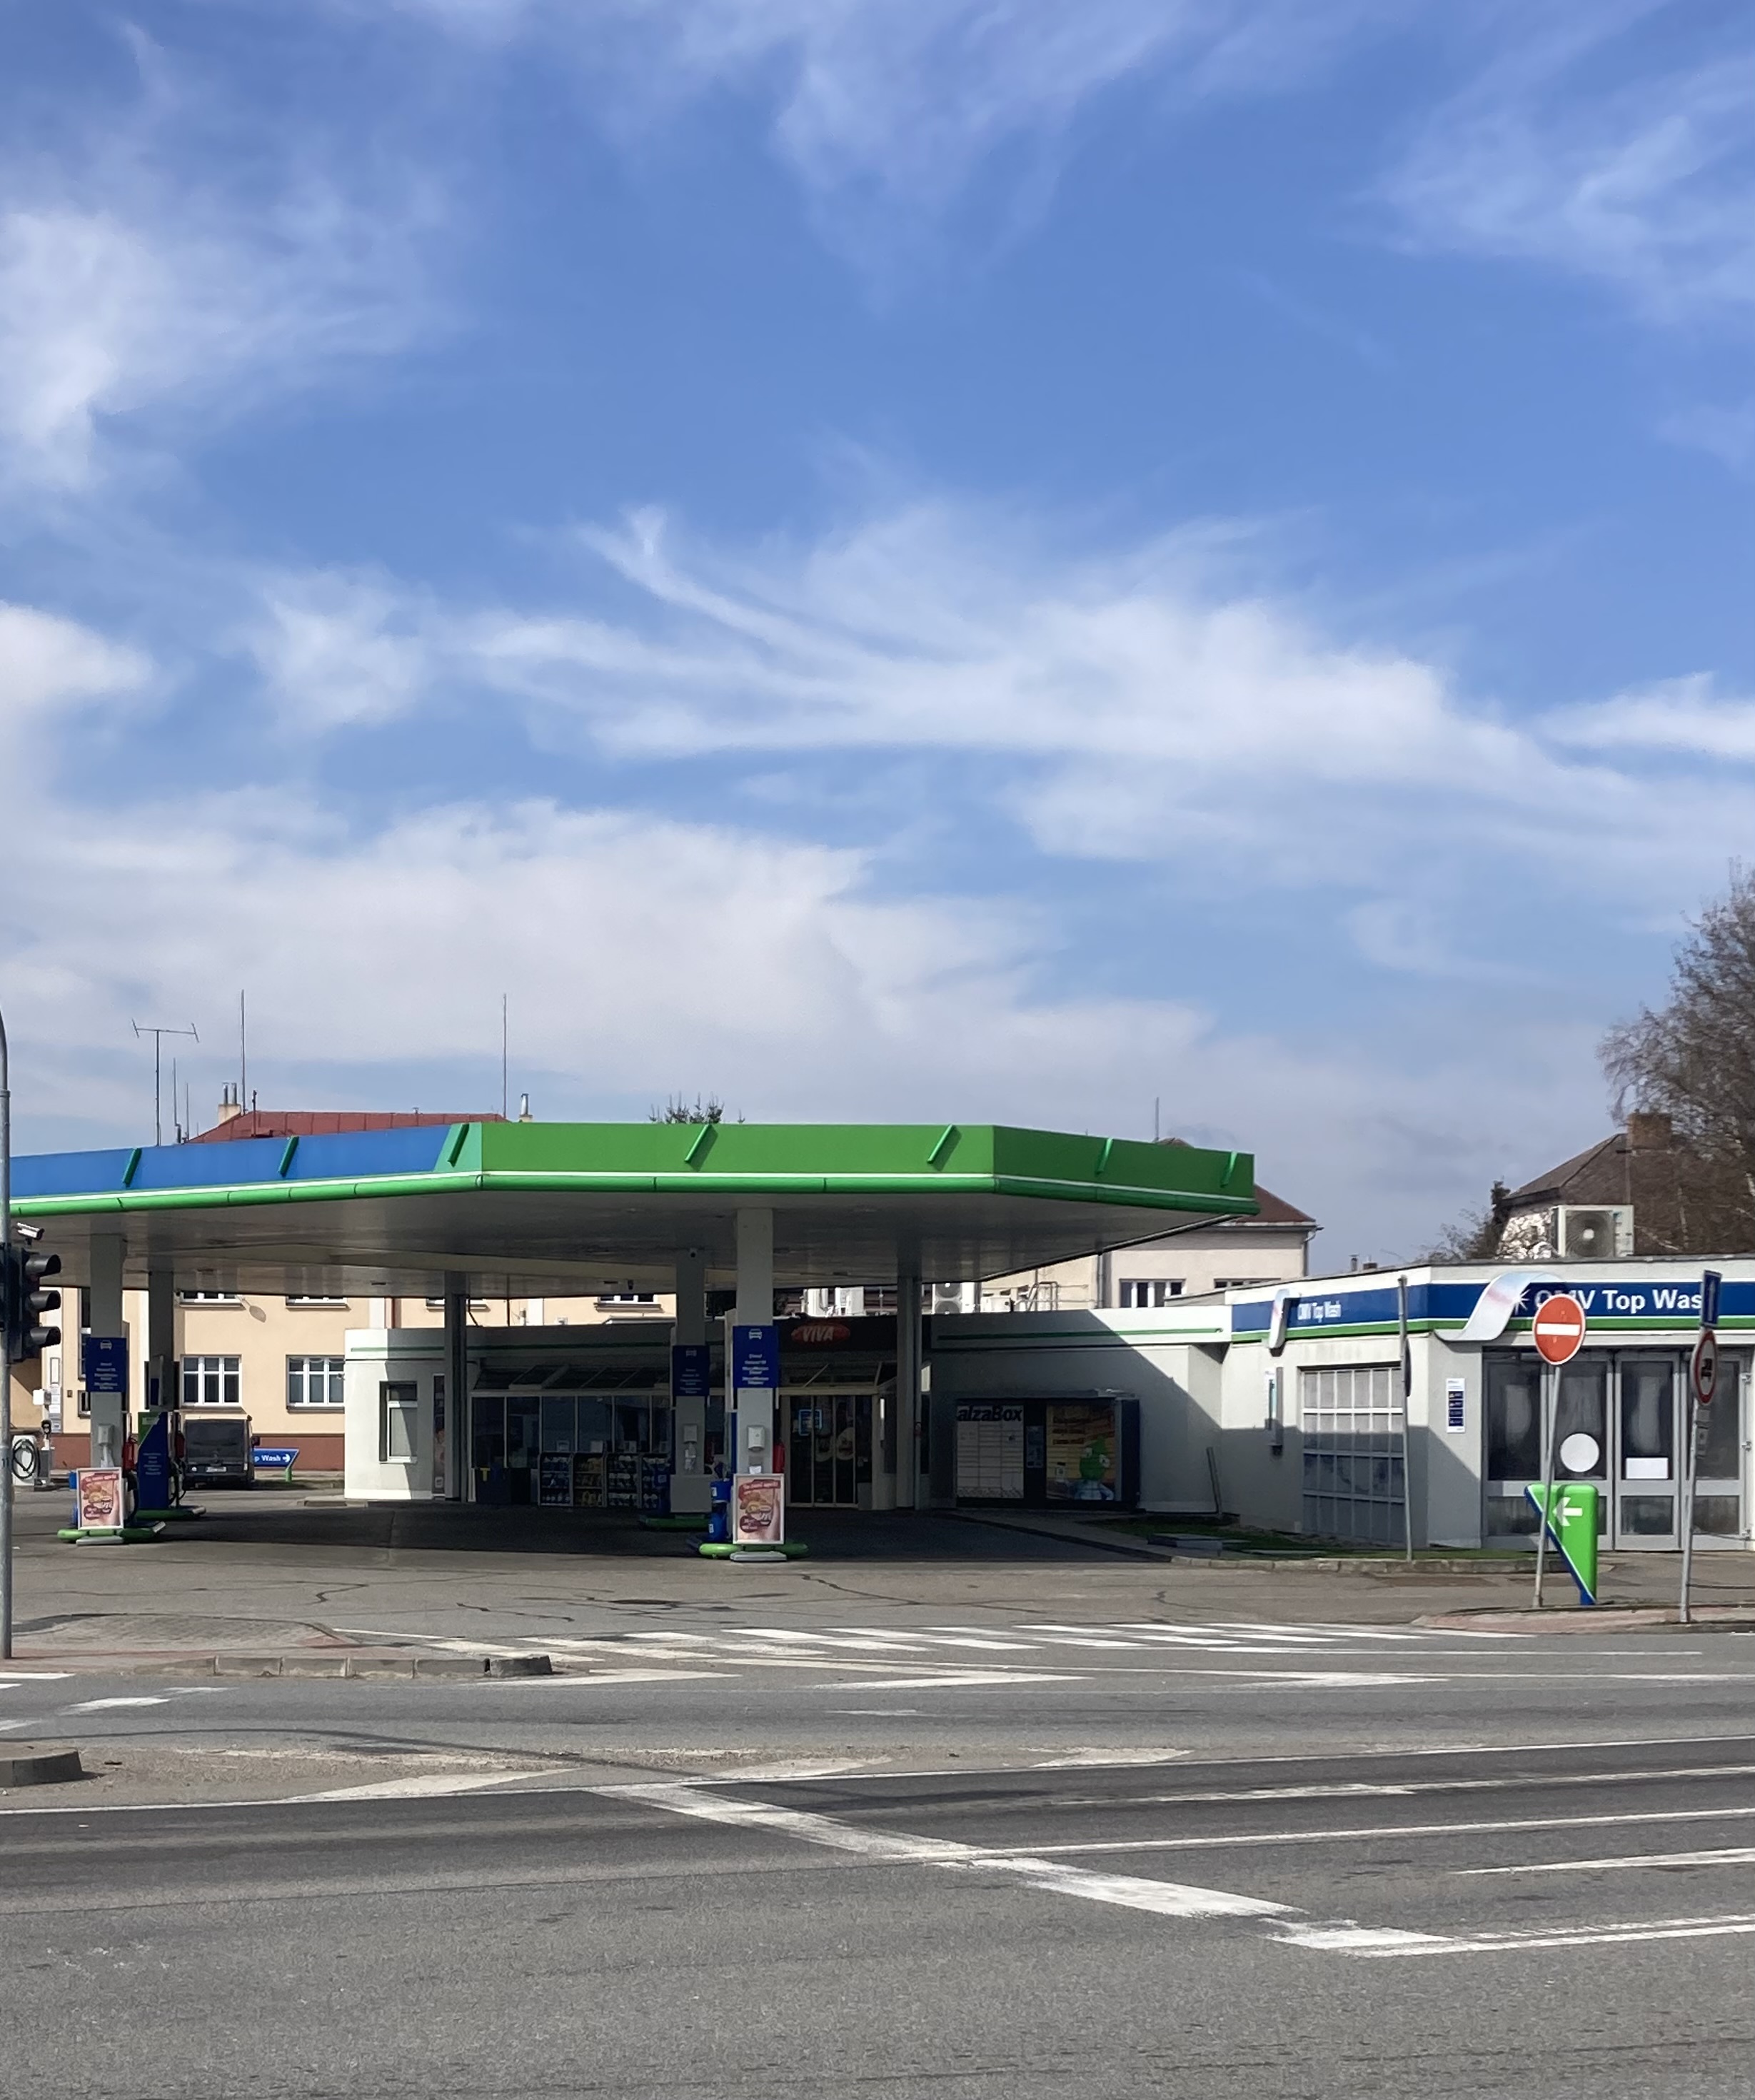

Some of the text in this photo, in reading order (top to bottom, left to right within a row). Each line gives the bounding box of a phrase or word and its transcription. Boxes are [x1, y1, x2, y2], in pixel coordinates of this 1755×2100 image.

[1534, 1289, 1703, 1313] OV Top Was
[803, 1326, 834, 1342] VIVA
[957, 1405, 1023, 1422] alzaBox
